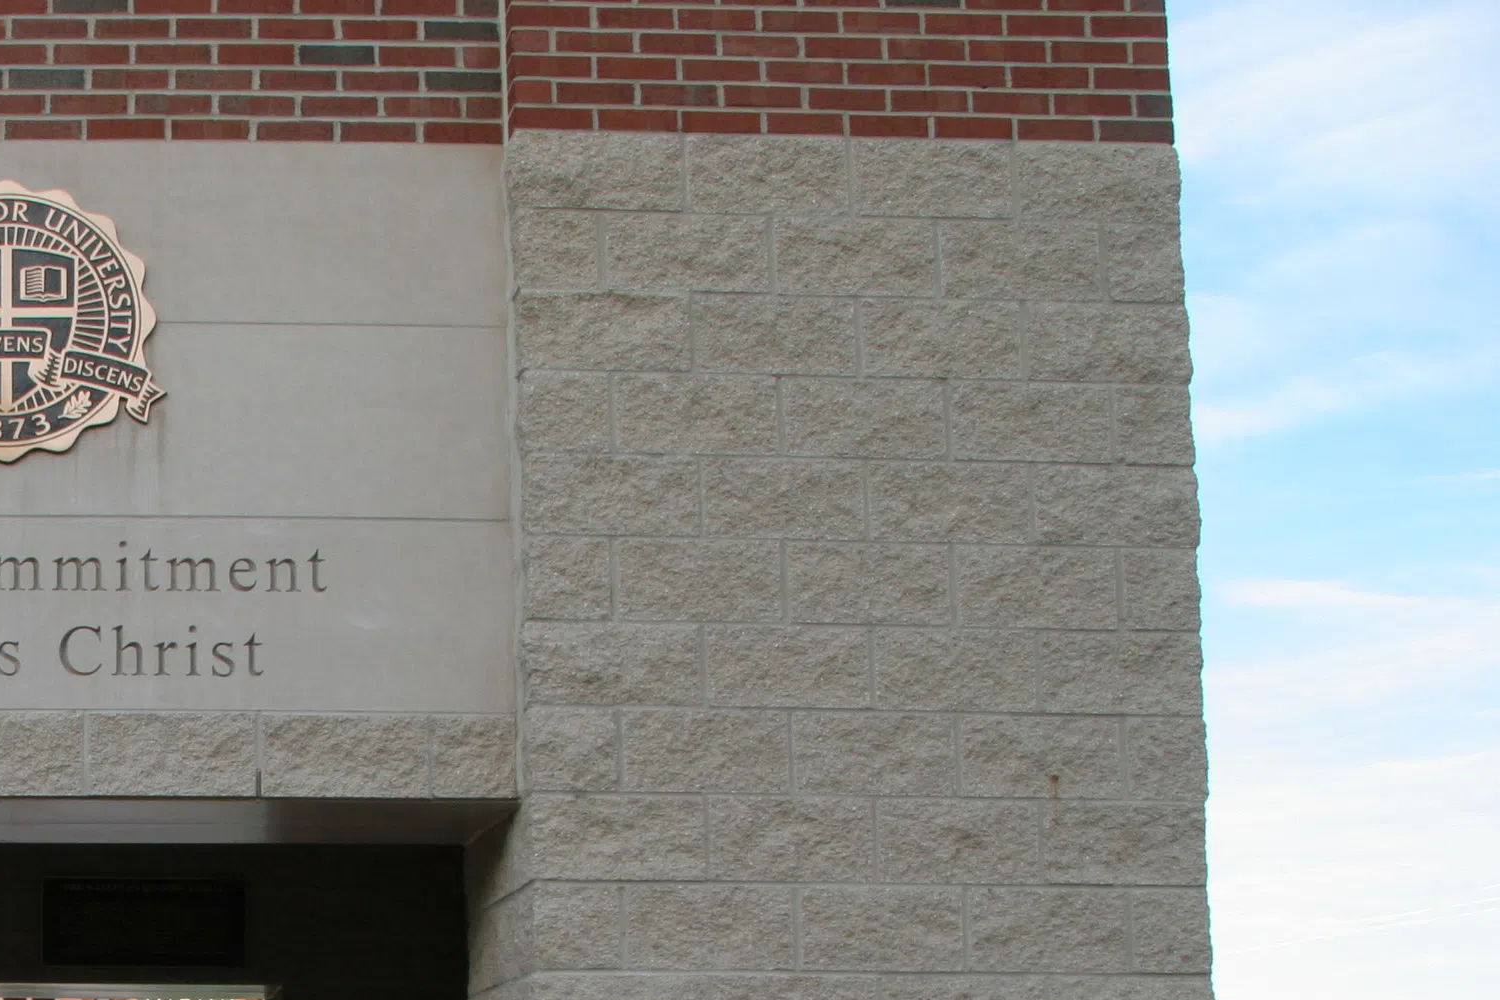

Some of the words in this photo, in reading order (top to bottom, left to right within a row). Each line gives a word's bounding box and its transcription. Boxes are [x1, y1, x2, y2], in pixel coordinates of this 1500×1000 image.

[44, 208, 133, 353] UNIVERSITY
[64, 357, 144, 392] DISCENS
[58, 625, 265, 678] Christ
